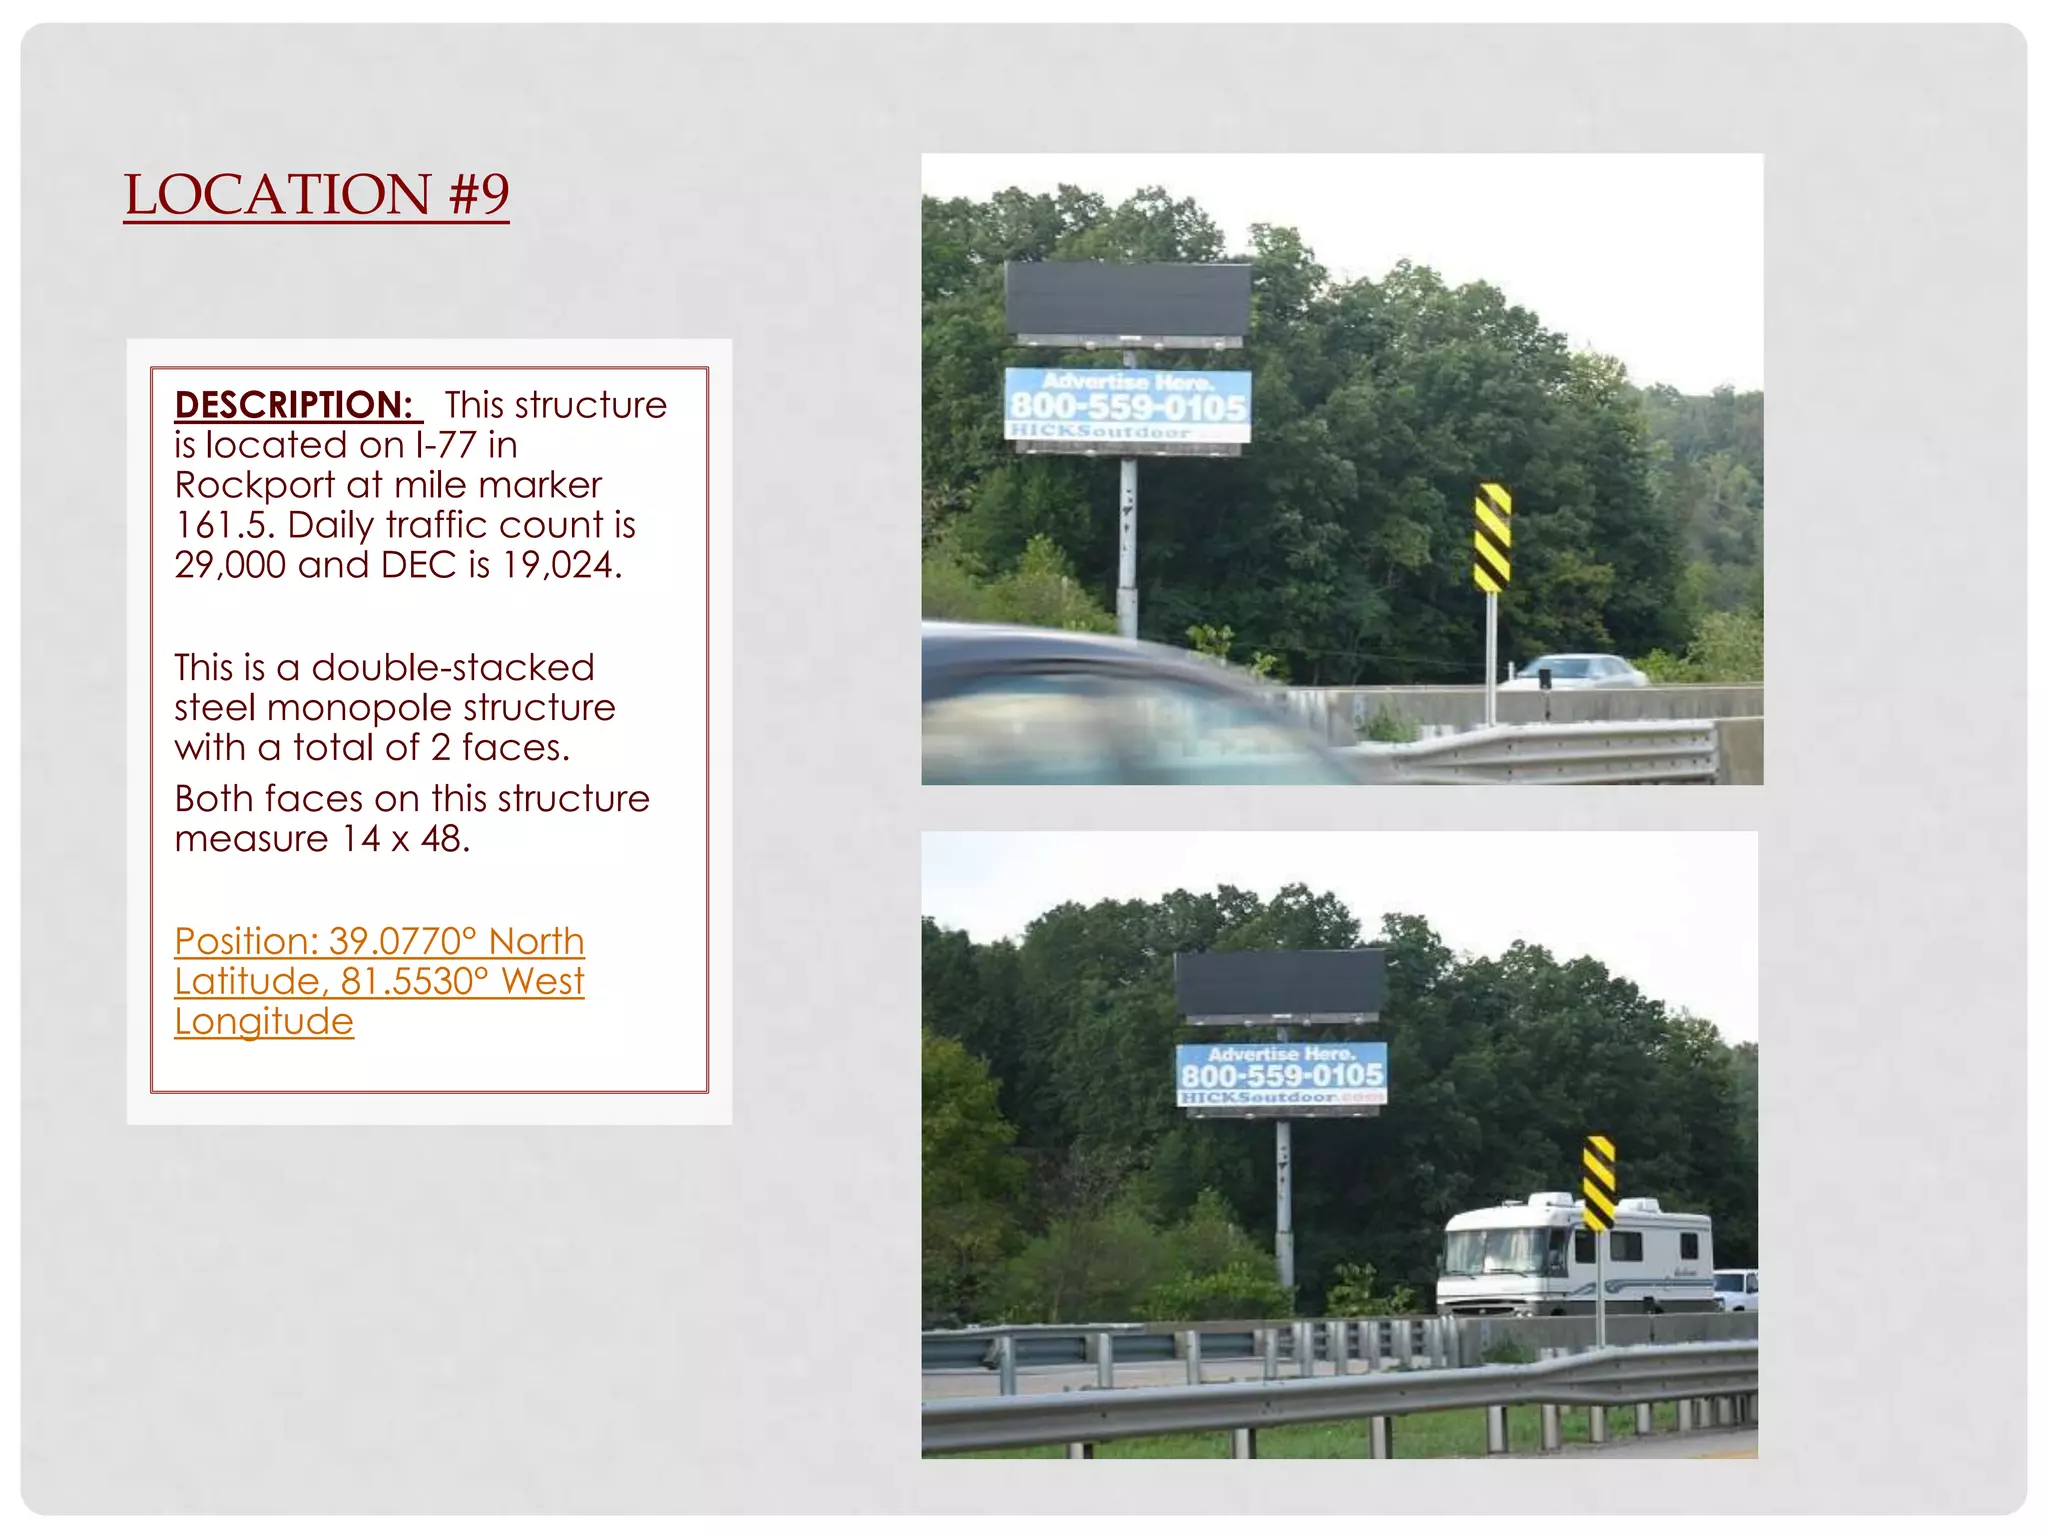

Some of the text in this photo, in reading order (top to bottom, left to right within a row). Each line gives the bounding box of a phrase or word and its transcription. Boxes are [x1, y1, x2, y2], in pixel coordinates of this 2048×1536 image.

[123, 173, 510, 216] LOCATION #9
[1042, 372, 1216, 392] Advertise Here.
[175, 389, 668, 420] DESCRIPTION: This structure
[1010, 391, 1248, 421] 800-559-0105
[174, 429, 517, 459] is located on I-77 in
[176, 469, 604, 506] Rockport at mile marker
[178, 509, 636, 546] 161.5. Daily traffic count is
[174, 549, 622, 582] 29,000 and DEC is 19,024.
[173, 651, 594, 682] This is a double-stacked
[174, 691, 616, 729] steel monopole structure
[173, 731, 570, 762] with a total of 2 faces.
[176, 782, 651, 813] Both faces on this structure
[175, 823, 470, 853] measure 14 x 48.
[175, 926, 585, 956] Position: 39.0770° North
[174, 966, 585, 998] Latitude, 81.5530° West
[175, 1005, 354, 1042] Longitude
[1208, 1047, 1357, 1062] Advertise Here.
[1181, 1063, 1384, 1089] 800-559-0105
[1181, 1091, 1385, 1105] HICKSoutdoor.com
